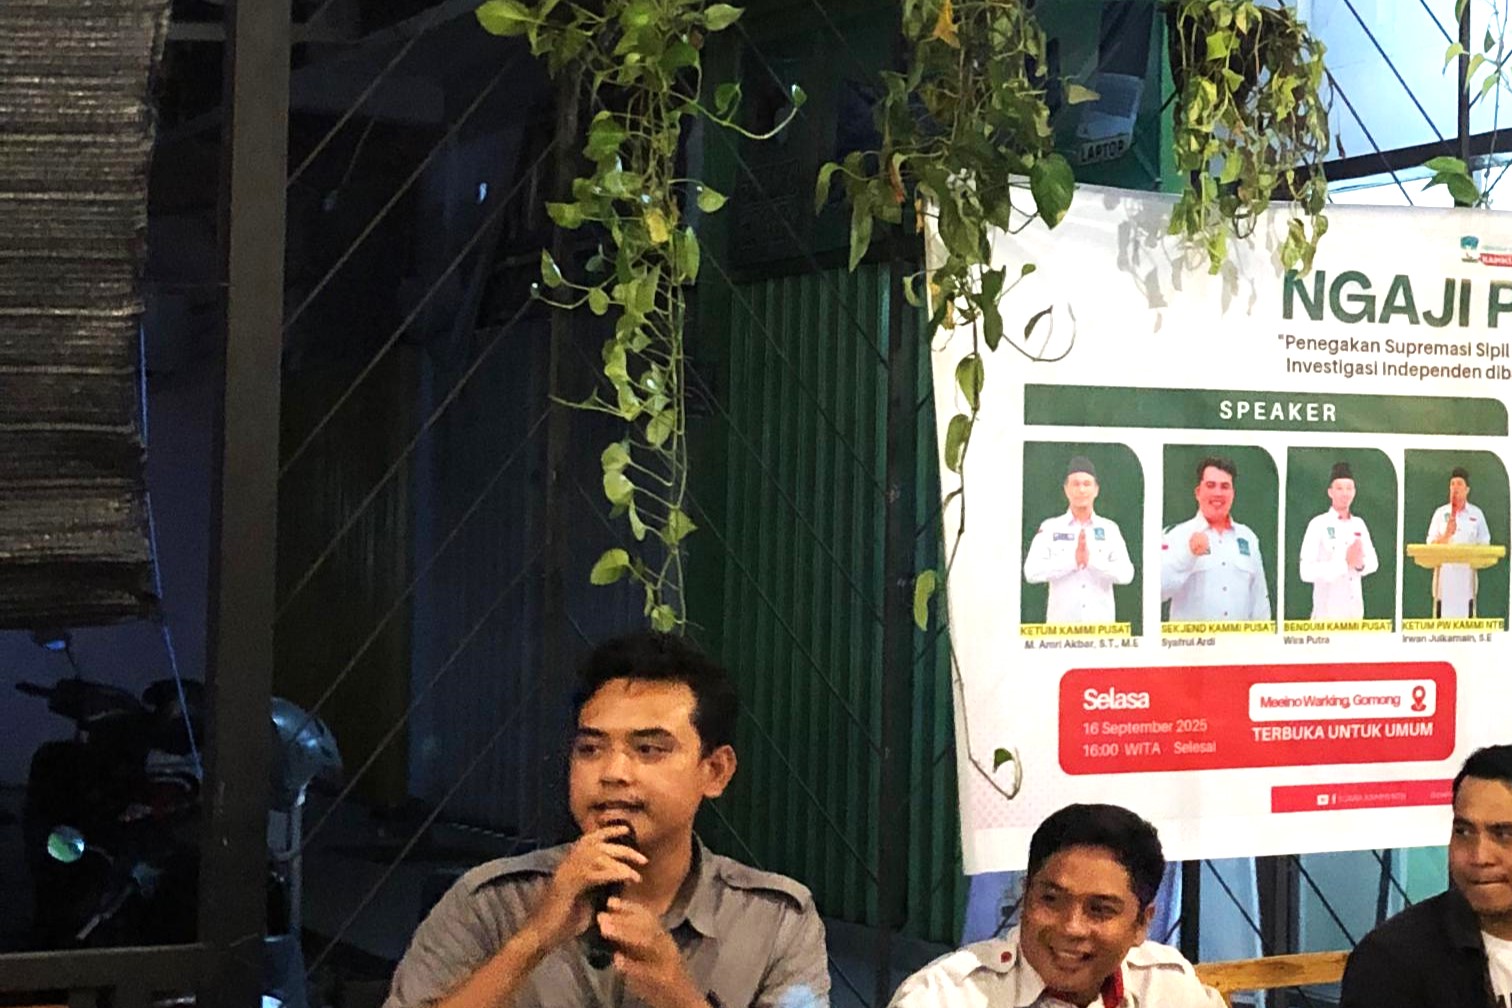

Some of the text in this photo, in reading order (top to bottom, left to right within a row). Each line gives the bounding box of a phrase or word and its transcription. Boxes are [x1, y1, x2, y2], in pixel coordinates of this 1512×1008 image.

[1282, 269, 1471, 329] NGAJI
[1277, 333, 1381, 355] "Penegakan
[1385, 338, 1472, 358] Supremasi
[1476, 342, 1509, 360] Sipil
[1286, 357, 1378, 378] Investigasi
[1382, 361, 1482, 380] Independen
[1219, 400, 1337, 422] SPEAKER
[1020, 624, 1131, 635] KETUM KAMMI PUSAT
[1161, 622, 1275, 633] SEKJEND KAMMI PUSAT
[1283, 621, 1392, 632] BENDUM KAMMI PUSAT
[1402, 620, 1505, 630] KETUM PW KAMMI NTB
[1196, 637, 1216, 646] Ardi
[1283, 635, 1330, 645] Wira Putra
[1082, 687, 1150, 711] Selasa
[1353, 694, 1401, 708] Gomong
[1083, 719, 1208, 737] 16 September 2025
[1251, 722, 1434, 742] TERBUKA UNTUK UMUM
[1083, 741, 1217, 757] 16:00 WITA Selesai
